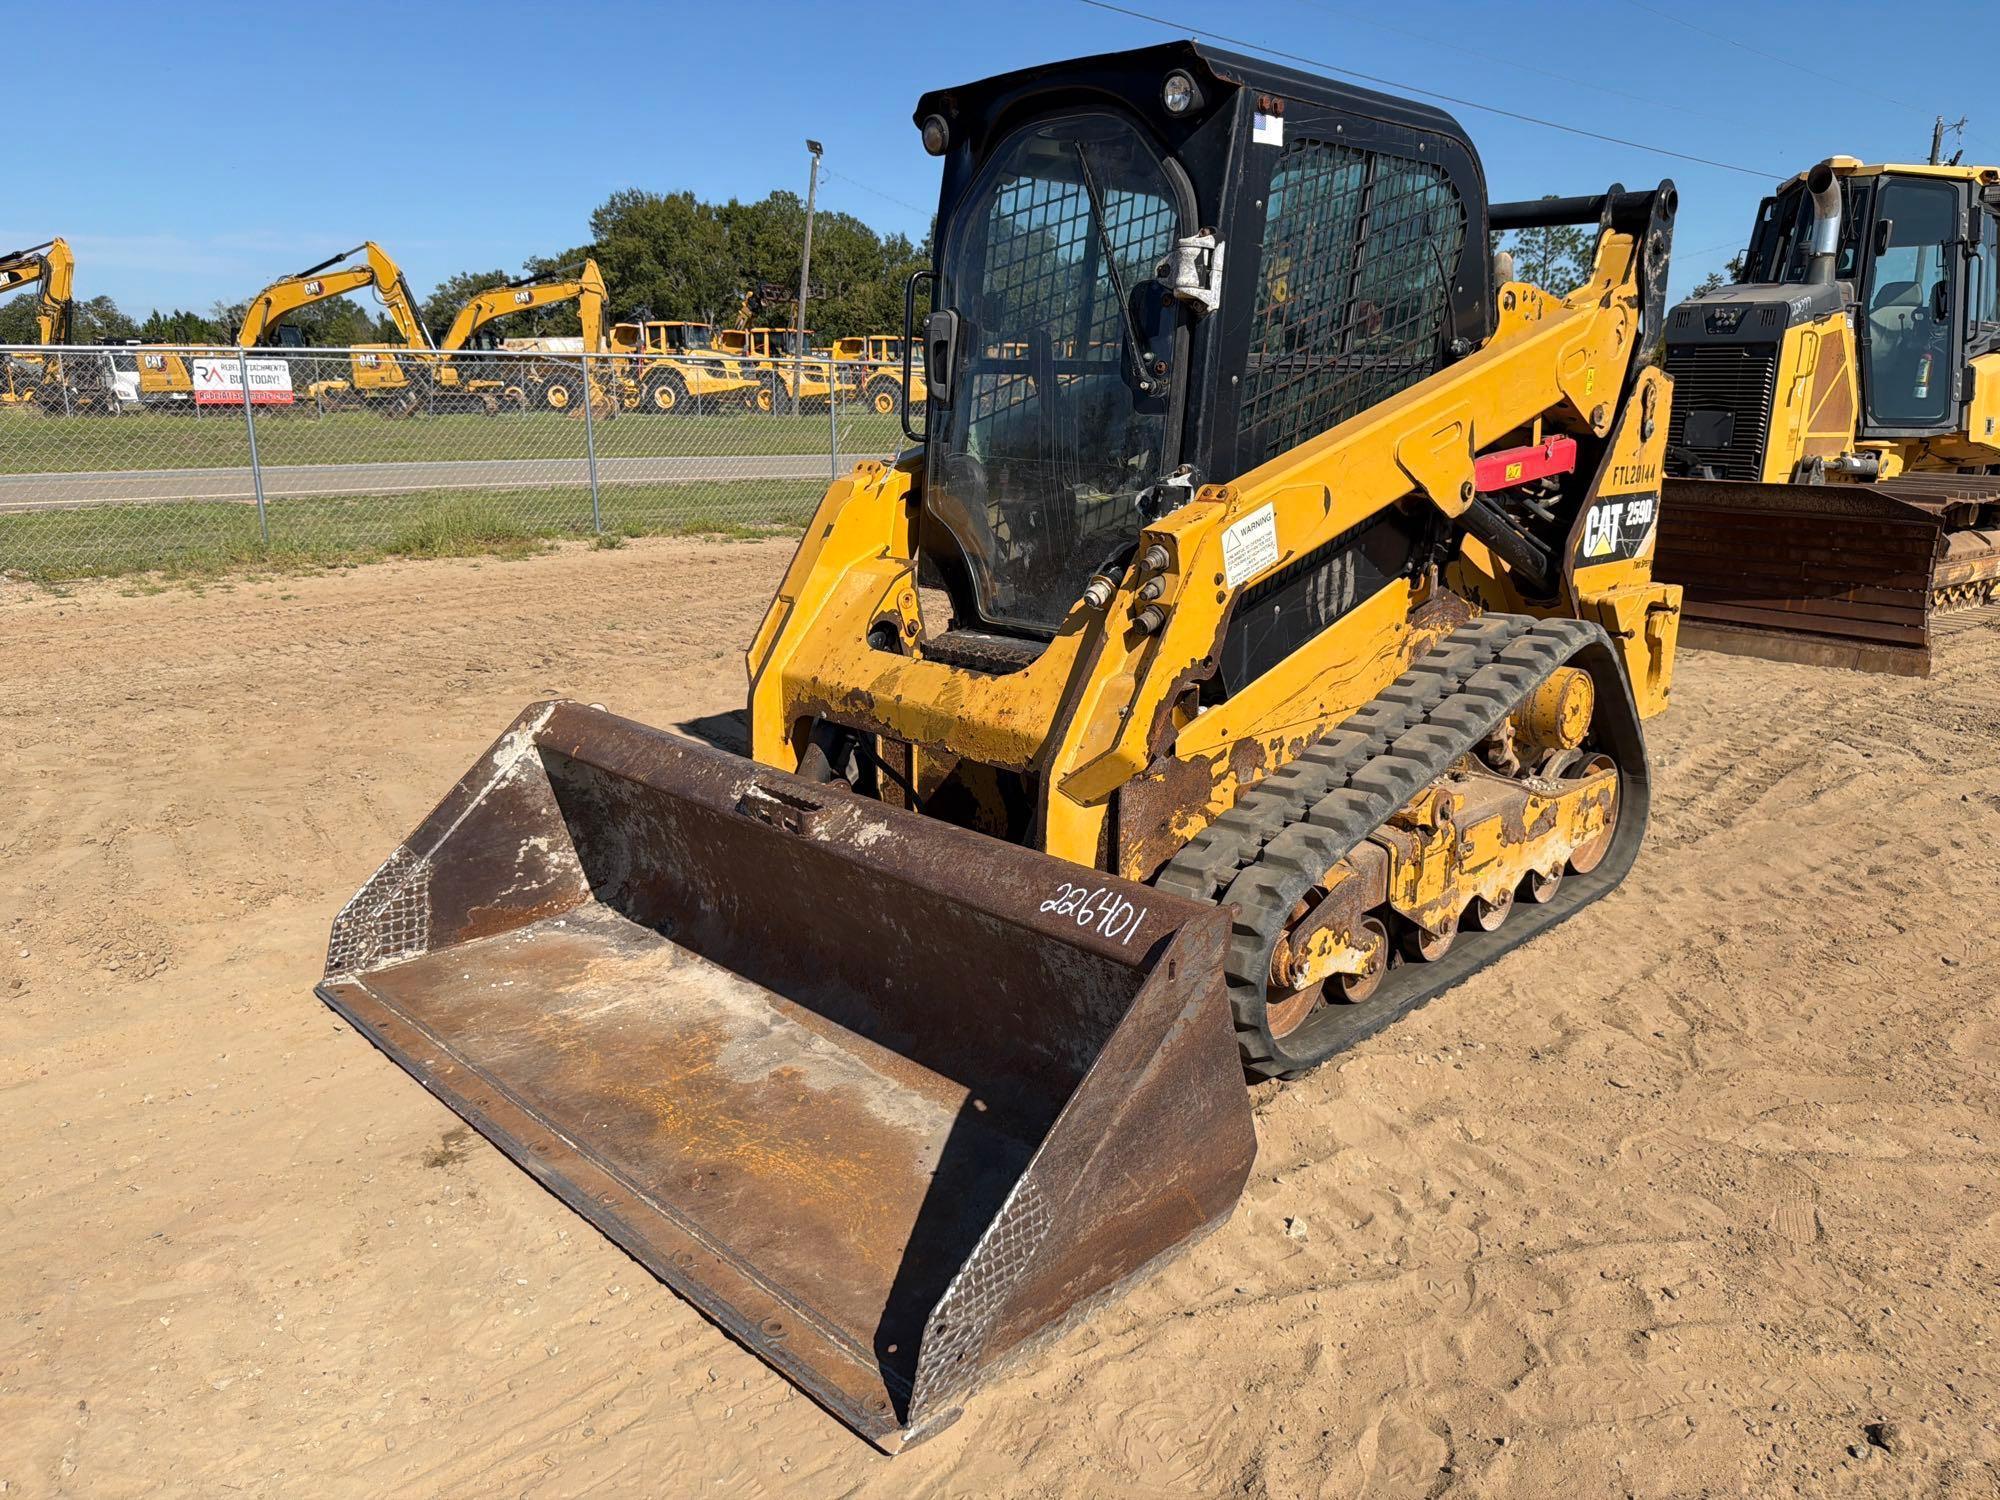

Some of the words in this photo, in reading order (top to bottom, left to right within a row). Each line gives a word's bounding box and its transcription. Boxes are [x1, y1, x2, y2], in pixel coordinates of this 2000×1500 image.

[304, 281, 320, 295] CAT
[514, 291, 530, 304] CAT
[145, 355, 163, 369] CAT
[359, 353, 377, 367] CAT
[243, 364, 287, 372] TACHMENTS
[230, 374, 246, 385] BU
[250, 374, 281, 385] TODAY!
[199, 390, 291, 400] RebelAttacments.com
[1613, 464, 1656, 486] FTL20144
[1241, 512, 1272, 536] WARNING
[1583, 503, 1624, 558] CAT
[1626, 499, 1653, 526] 259D
[1040, 882, 1147, 945] 226401
